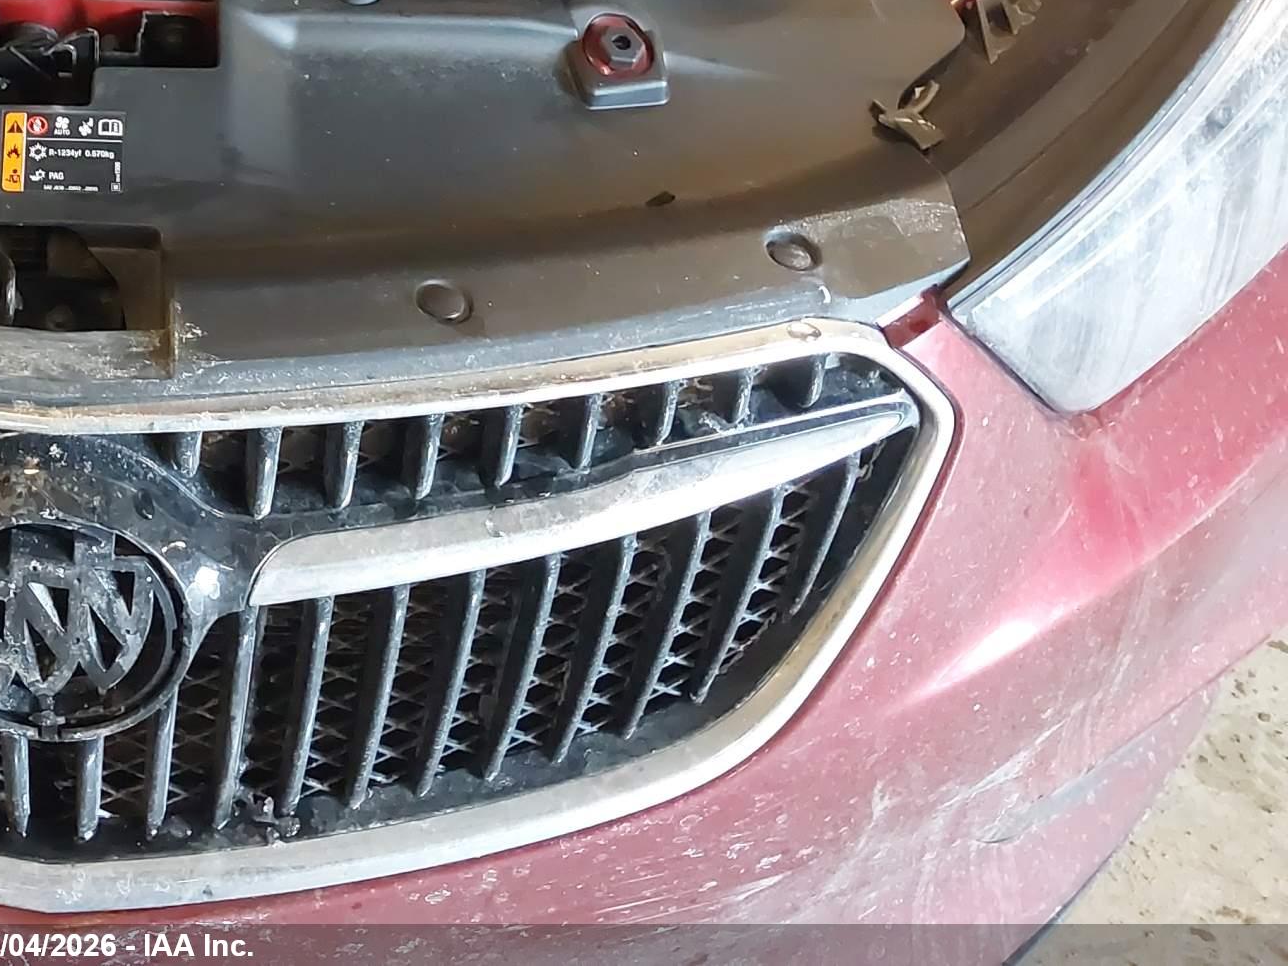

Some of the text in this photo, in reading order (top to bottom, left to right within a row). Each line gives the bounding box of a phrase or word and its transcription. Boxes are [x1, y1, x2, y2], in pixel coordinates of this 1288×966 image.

[53, 128, 71, 136] AUTO
[48, 148, 82, 159] R-1234yf
[48, 171, 64, 181] PAG
